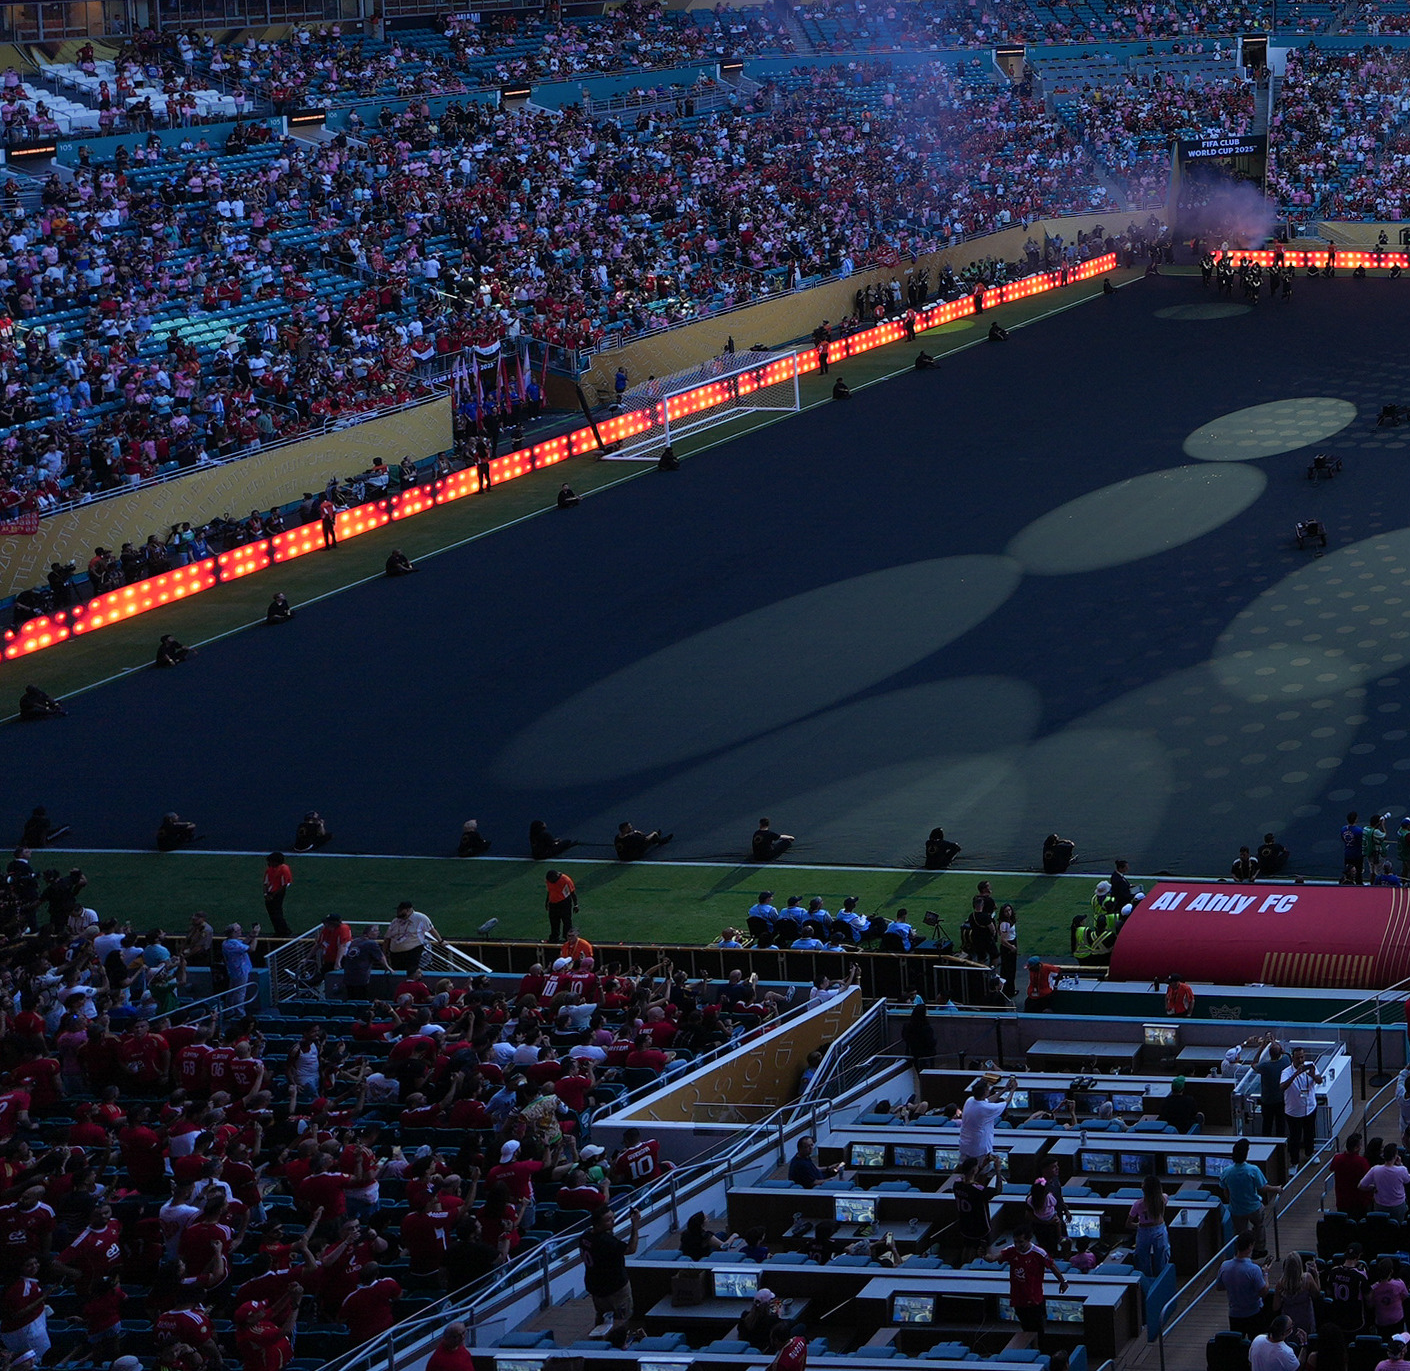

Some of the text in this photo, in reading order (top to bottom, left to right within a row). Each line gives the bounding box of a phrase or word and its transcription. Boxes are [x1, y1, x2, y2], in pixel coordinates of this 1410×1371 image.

[60, 144, 73, 152] 105
[1201, 138, 1240, 149] FIFA CLUB
[1187, 148, 1217, 158] WORLD
[1217, 147, 1235, 157] CUP
[1149, 891, 1298, 914] Al Ahly FC
[628, 1155, 655, 1181] 10
[1333, 1282, 1350, 1300] 10
